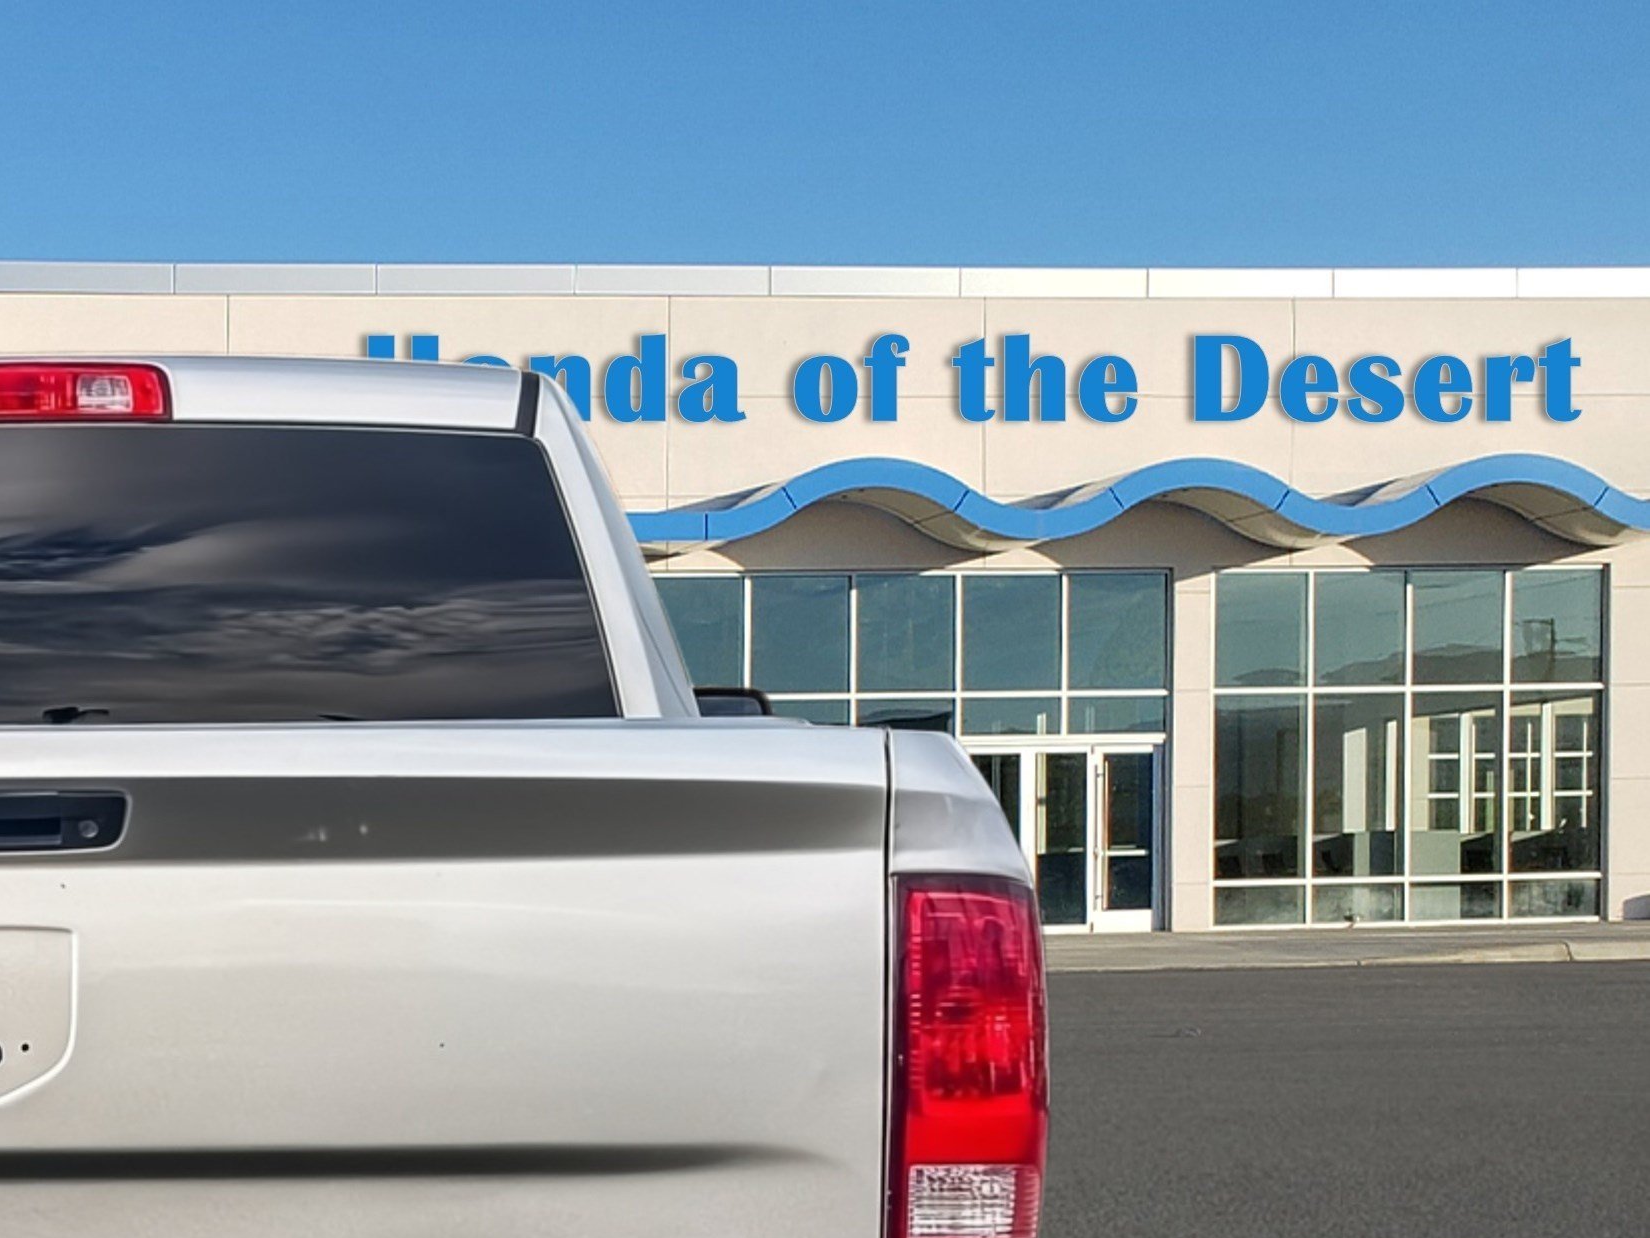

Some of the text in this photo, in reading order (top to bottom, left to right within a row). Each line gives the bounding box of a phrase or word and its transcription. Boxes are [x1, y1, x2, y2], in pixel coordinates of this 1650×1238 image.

[367, 333, 1584, 423] nda of the Desert
